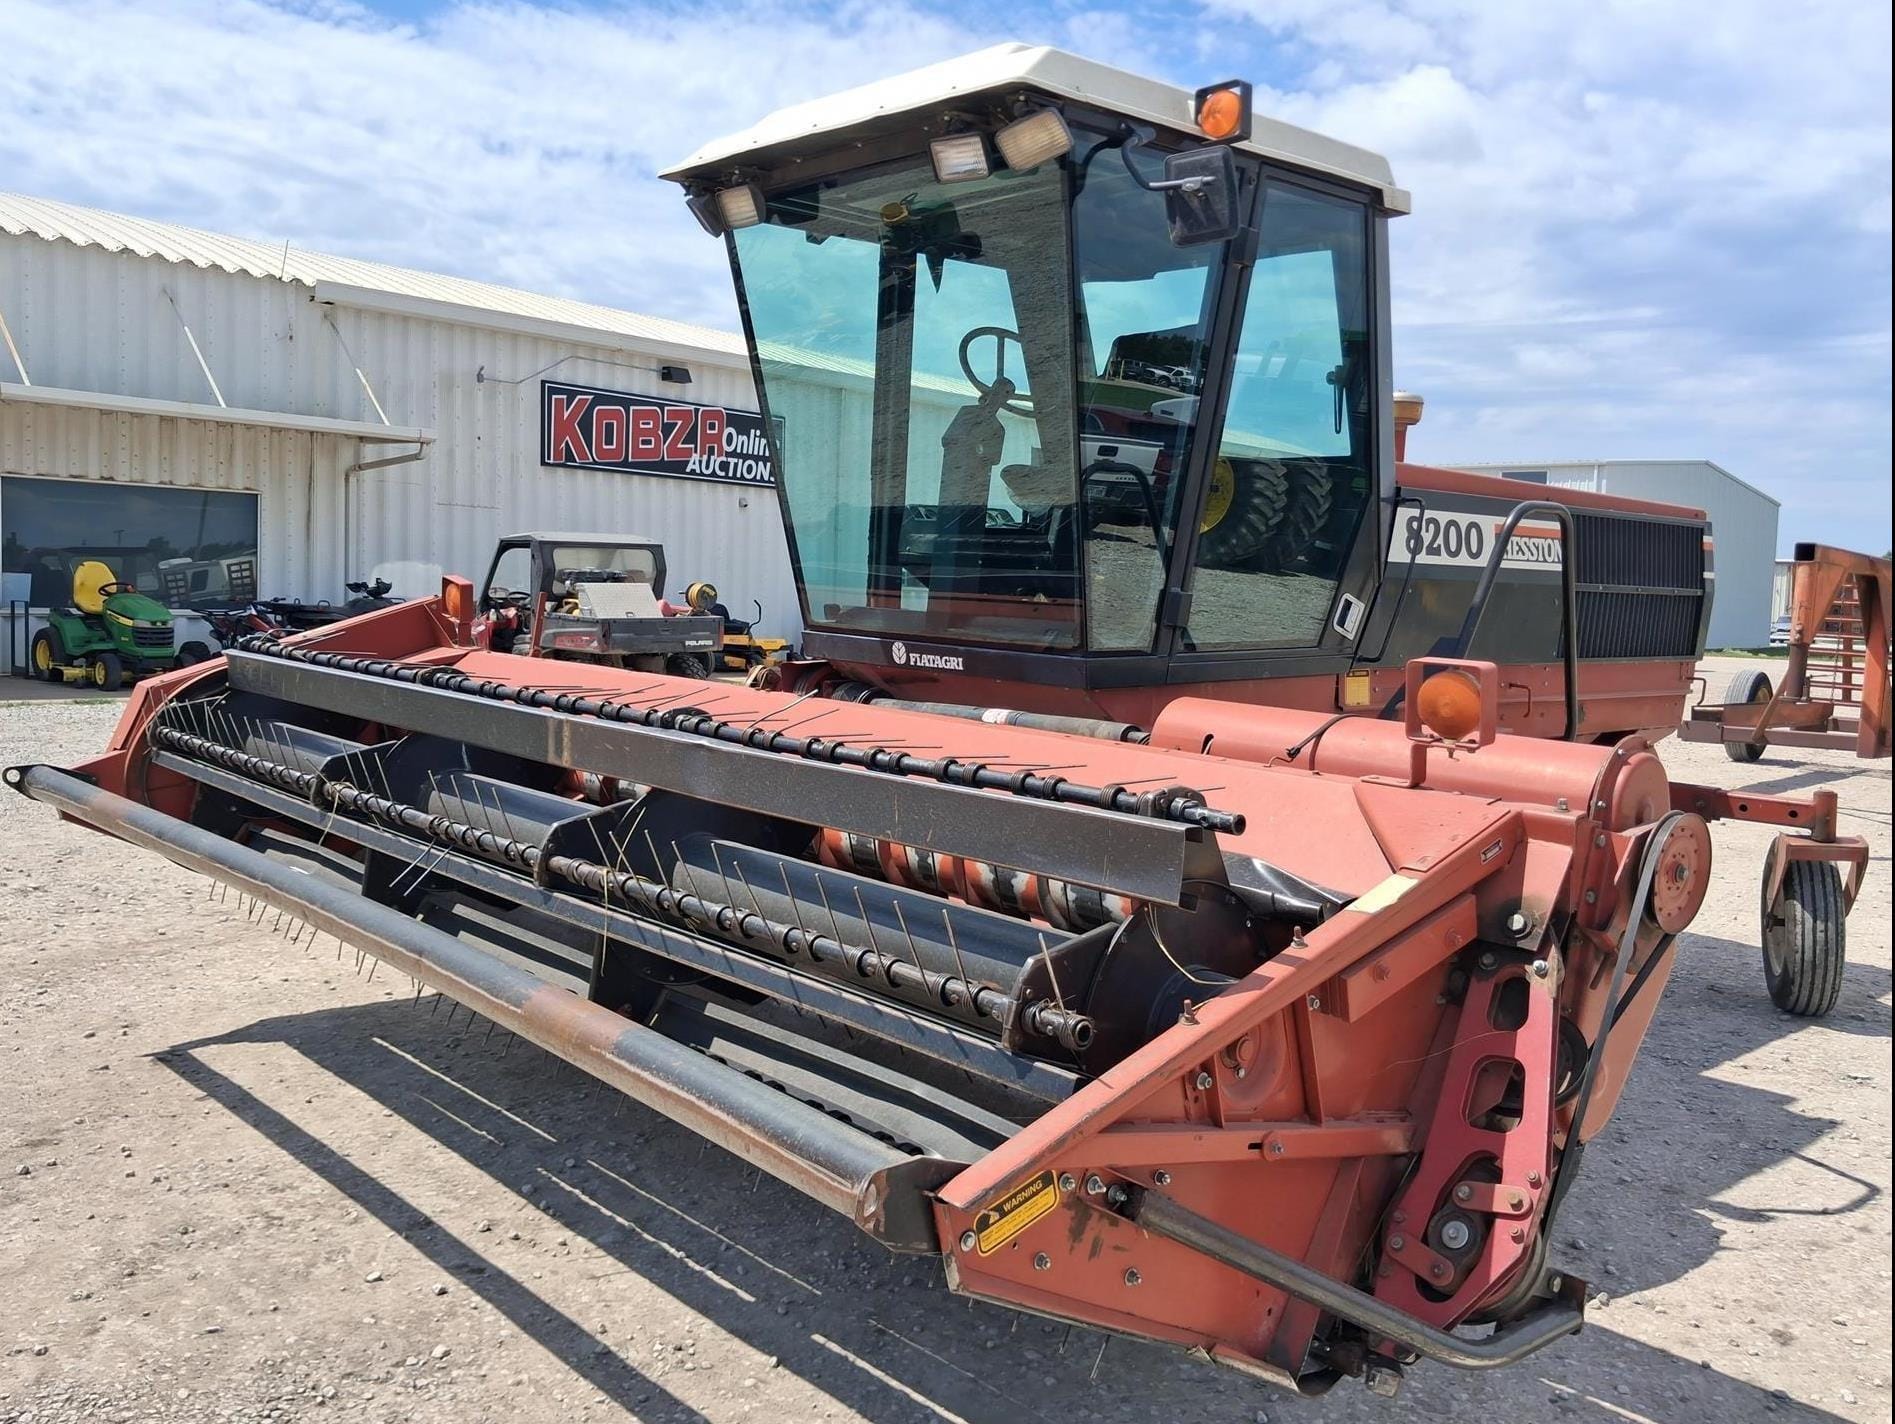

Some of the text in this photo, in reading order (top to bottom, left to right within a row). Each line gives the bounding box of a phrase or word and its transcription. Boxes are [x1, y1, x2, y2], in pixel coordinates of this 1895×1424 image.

[551, 394, 779, 463] KOBZA Onlin
[686, 453, 775, 481] AUCTION
[1405, 515, 1483, 560] 8200
[909, 653, 964, 670] FIATAGRI
[1002, 1180, 1043, 1212] WARNING
